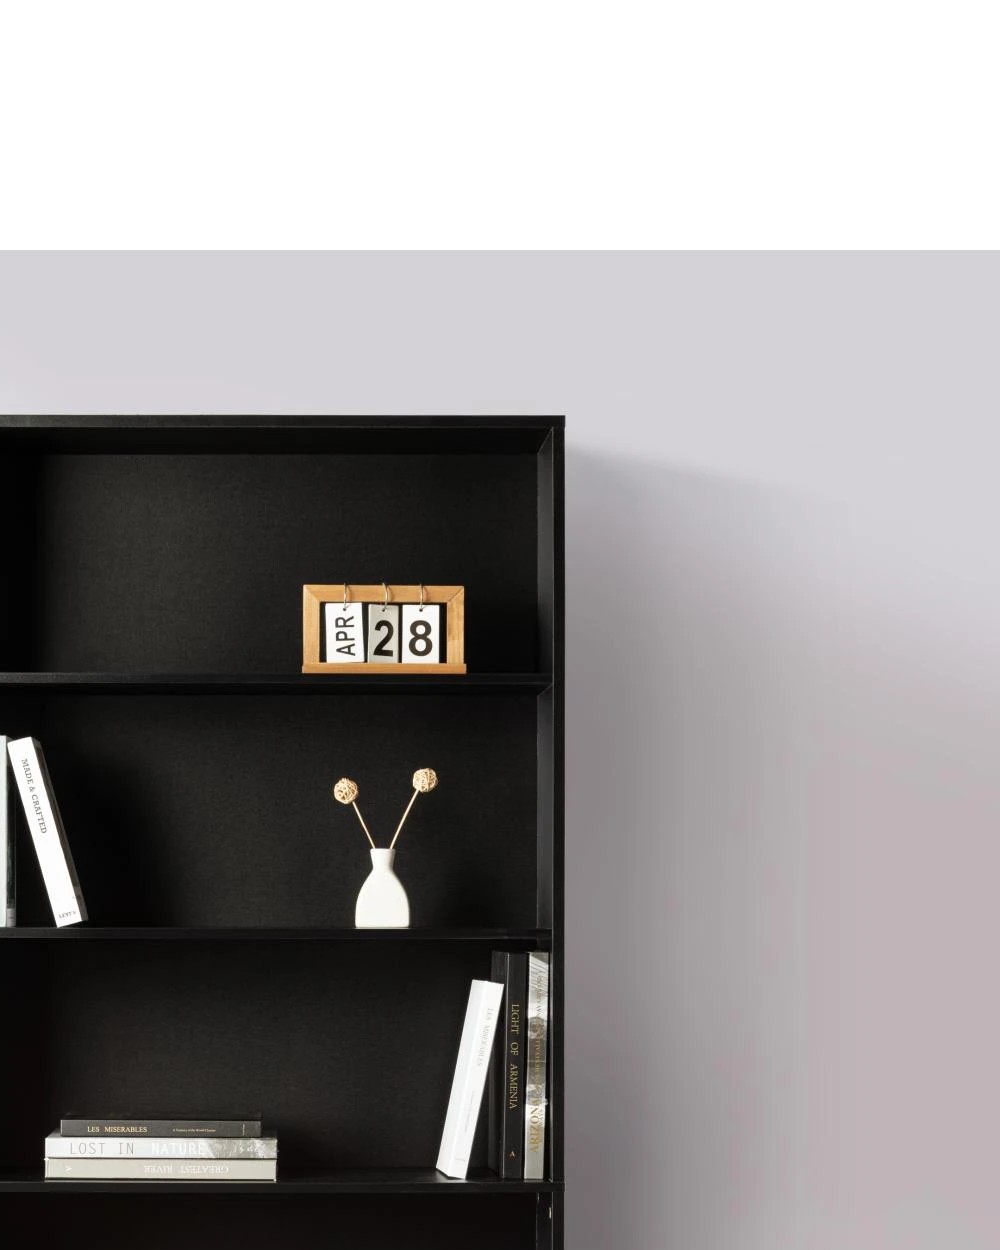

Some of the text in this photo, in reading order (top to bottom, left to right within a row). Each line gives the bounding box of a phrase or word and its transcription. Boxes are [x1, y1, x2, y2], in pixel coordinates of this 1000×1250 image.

[335, 616, 355, 656] APR
[21, 758, 34, 785] MADE
[31, 793, 48, 834] CRAFTED
[509, 1004, 520, 1110] LIGHT OF ARMENIA
[529, 1095, 540, 1153] ARIZONA
[70, 1142, 207, 1156] LOST IN NATURE
[180, 1165, 229, 1174] GREATEST
